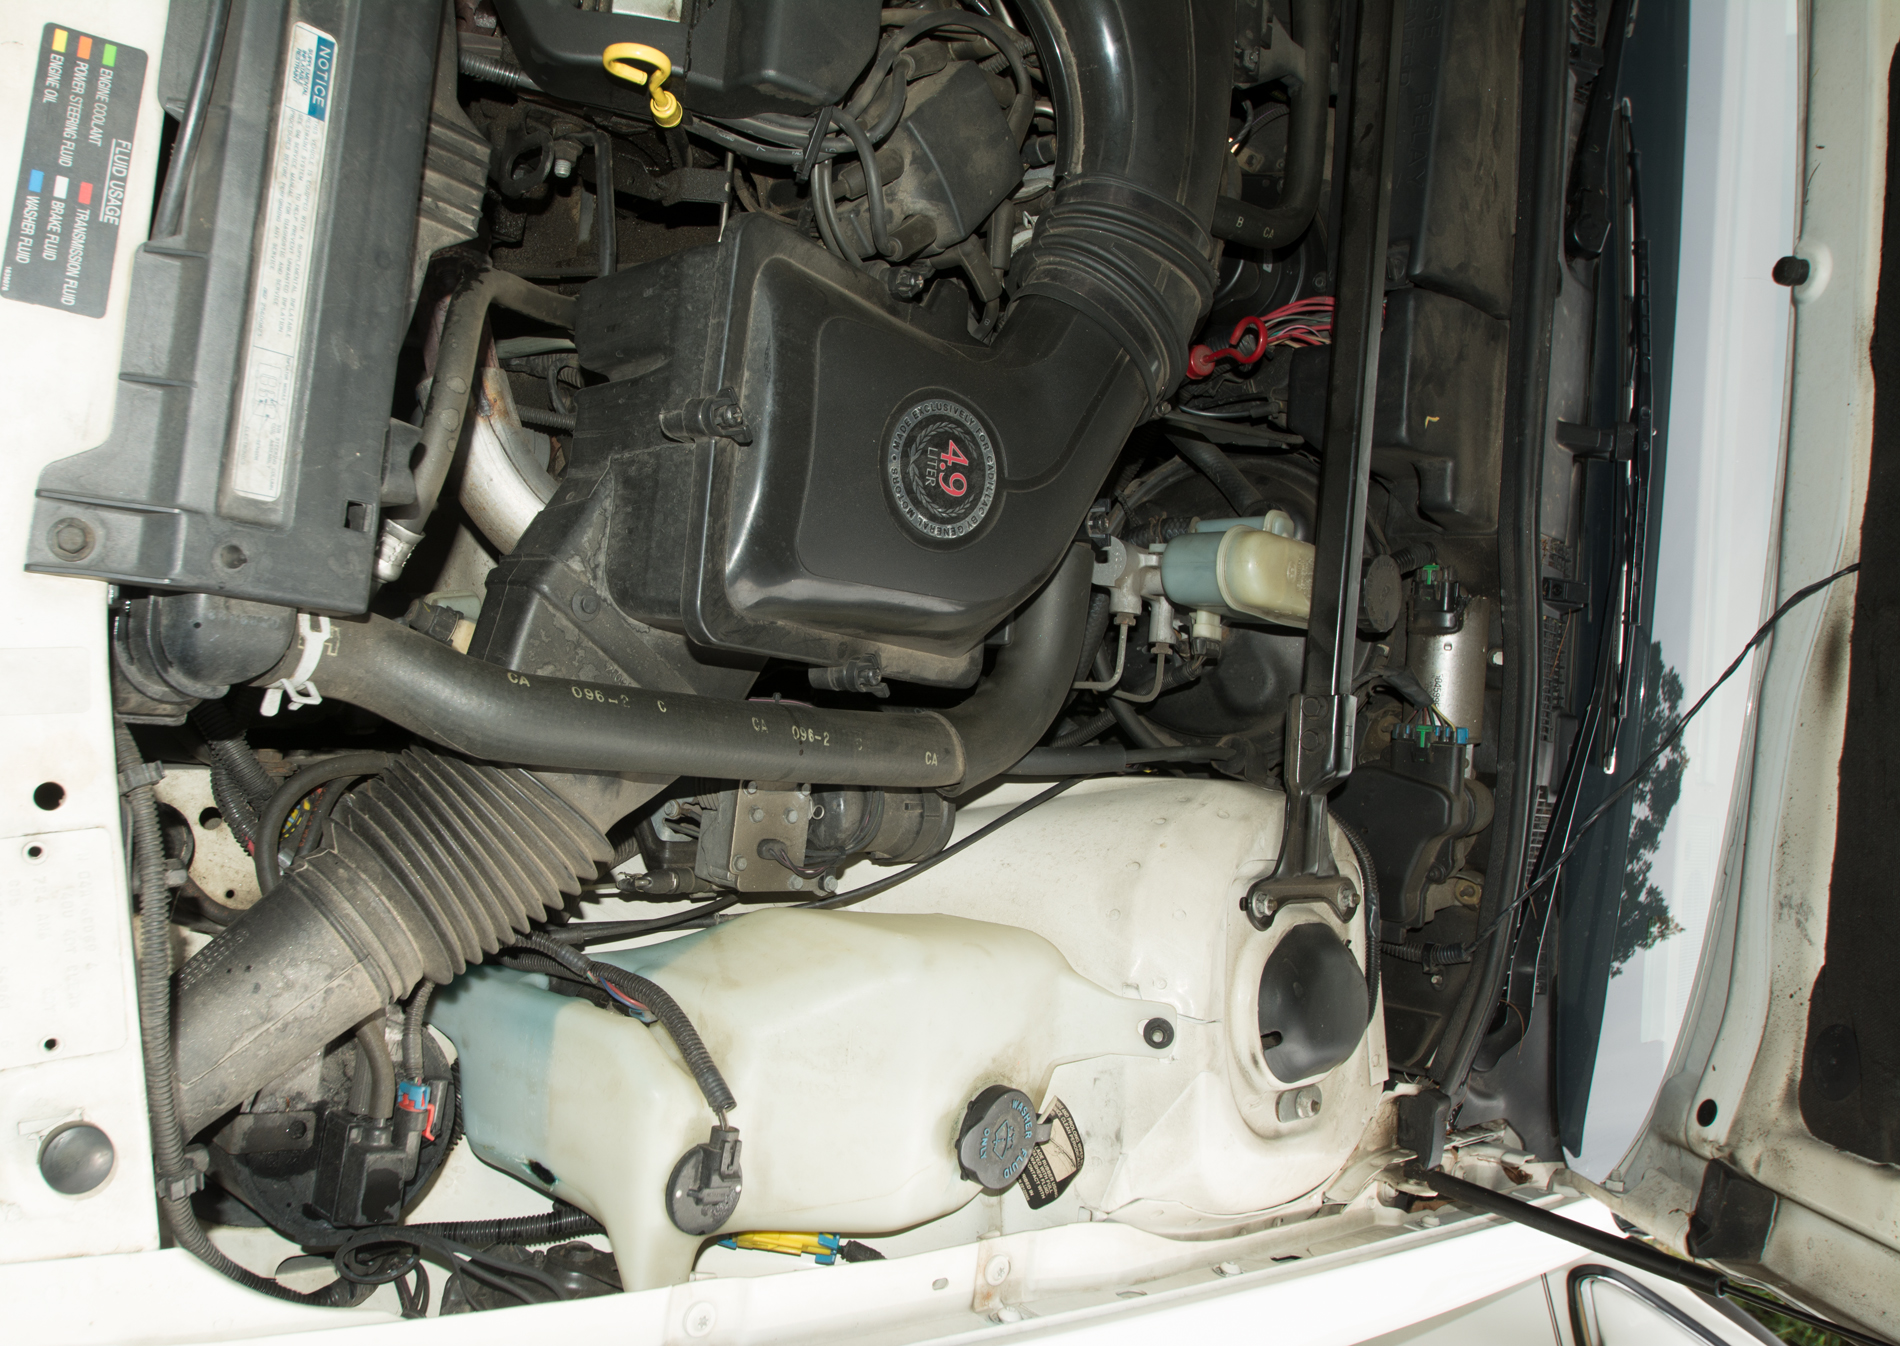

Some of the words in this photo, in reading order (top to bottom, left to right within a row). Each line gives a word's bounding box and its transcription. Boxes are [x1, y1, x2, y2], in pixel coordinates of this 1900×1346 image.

[44, 53, 64, 88] ENGINE
[70, 60, 88, 94] POWER
[95, 68, 113, 102] ENGINE
[312, 46, 331, 108] NOTICE
[41, 88, 57, 104] OIL
[62, 95, 82, 140] STEERING
[87, 102, 107, 147] COOLANT
[57, 140, 74, 168] FLUID
[111, 140, 131, 178] FLUID
[19, 196, 39, 236] WASHER
[46, 200, 64, 233] BRAKE
[103, 180, 124, 226] USAGE
[1236, 216, 1244, 228] B
[15, 236, 33, 264] FLUID
[41, 234, 59, 260] FLUID
[65, 208, 90, 278] TRANSMISSION
[60, 278, 78, 306] FLUID
[910, 402, 973, 426] EXCLUSIVELY
[891, 417, 910, 450] MADE
[974, 428, 990, 451] FOR
[924, 446, 938, 487] LITER
[938, 440, 968, 497] 4.9
[890, 468, 915, 520] MOTORS
[977, 455, 995, 516] CADILLAC
[916, 517, 964, 538] GENERAL
[965, 515, 978, 530] BY
[507, 672, 530, 688] CA
[752, 716, 768, 734] CA
[792, 725, 830, 746] 096-2
[924, 751, 938, 766] CA
[1011, 1098, 1033, 1139] WASHER
[980, 1128, 990, 1160] ONLY
[1003, 1148, 1028, 1179] FLUID
[1027, 1162, 1040, 1185] ONTACT
